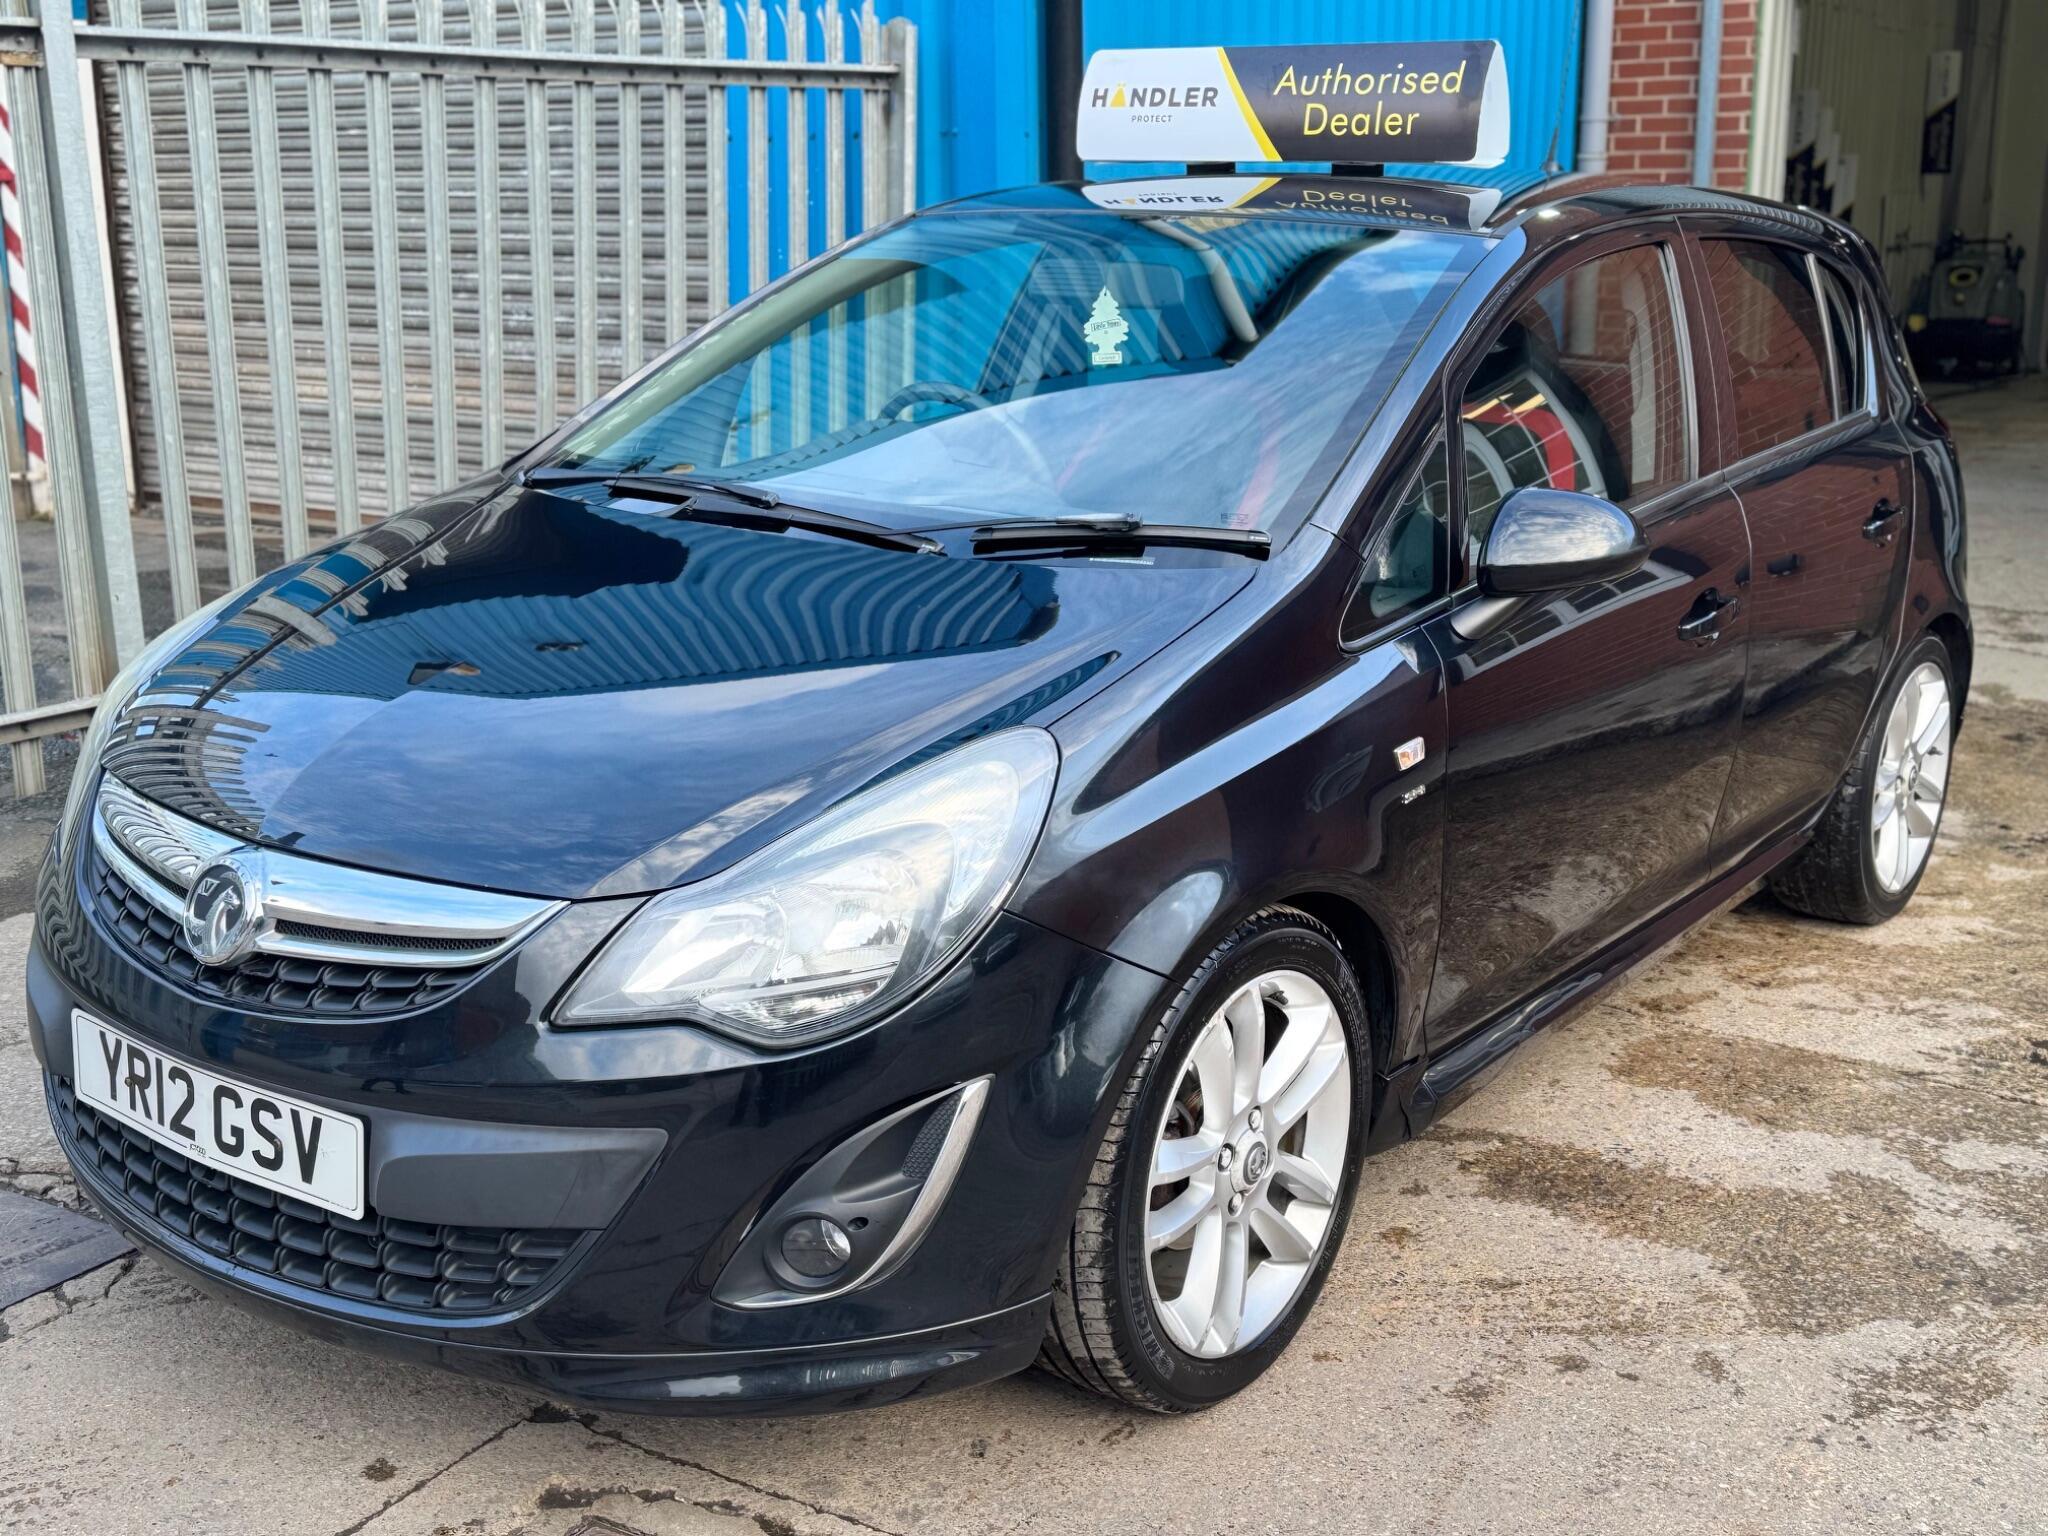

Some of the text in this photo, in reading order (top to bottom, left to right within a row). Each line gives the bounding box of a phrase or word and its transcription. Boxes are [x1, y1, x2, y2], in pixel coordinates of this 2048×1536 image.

[1092, 81, 1218, 108] HÄNDLER
[1273, 60, 1467, 98] Authorised
[1131, 114, 1174, 123] PROTECT
[1303, 101, 1420, 137] Dealer
[99, 1030, 323, 1185] YR12 GSV
